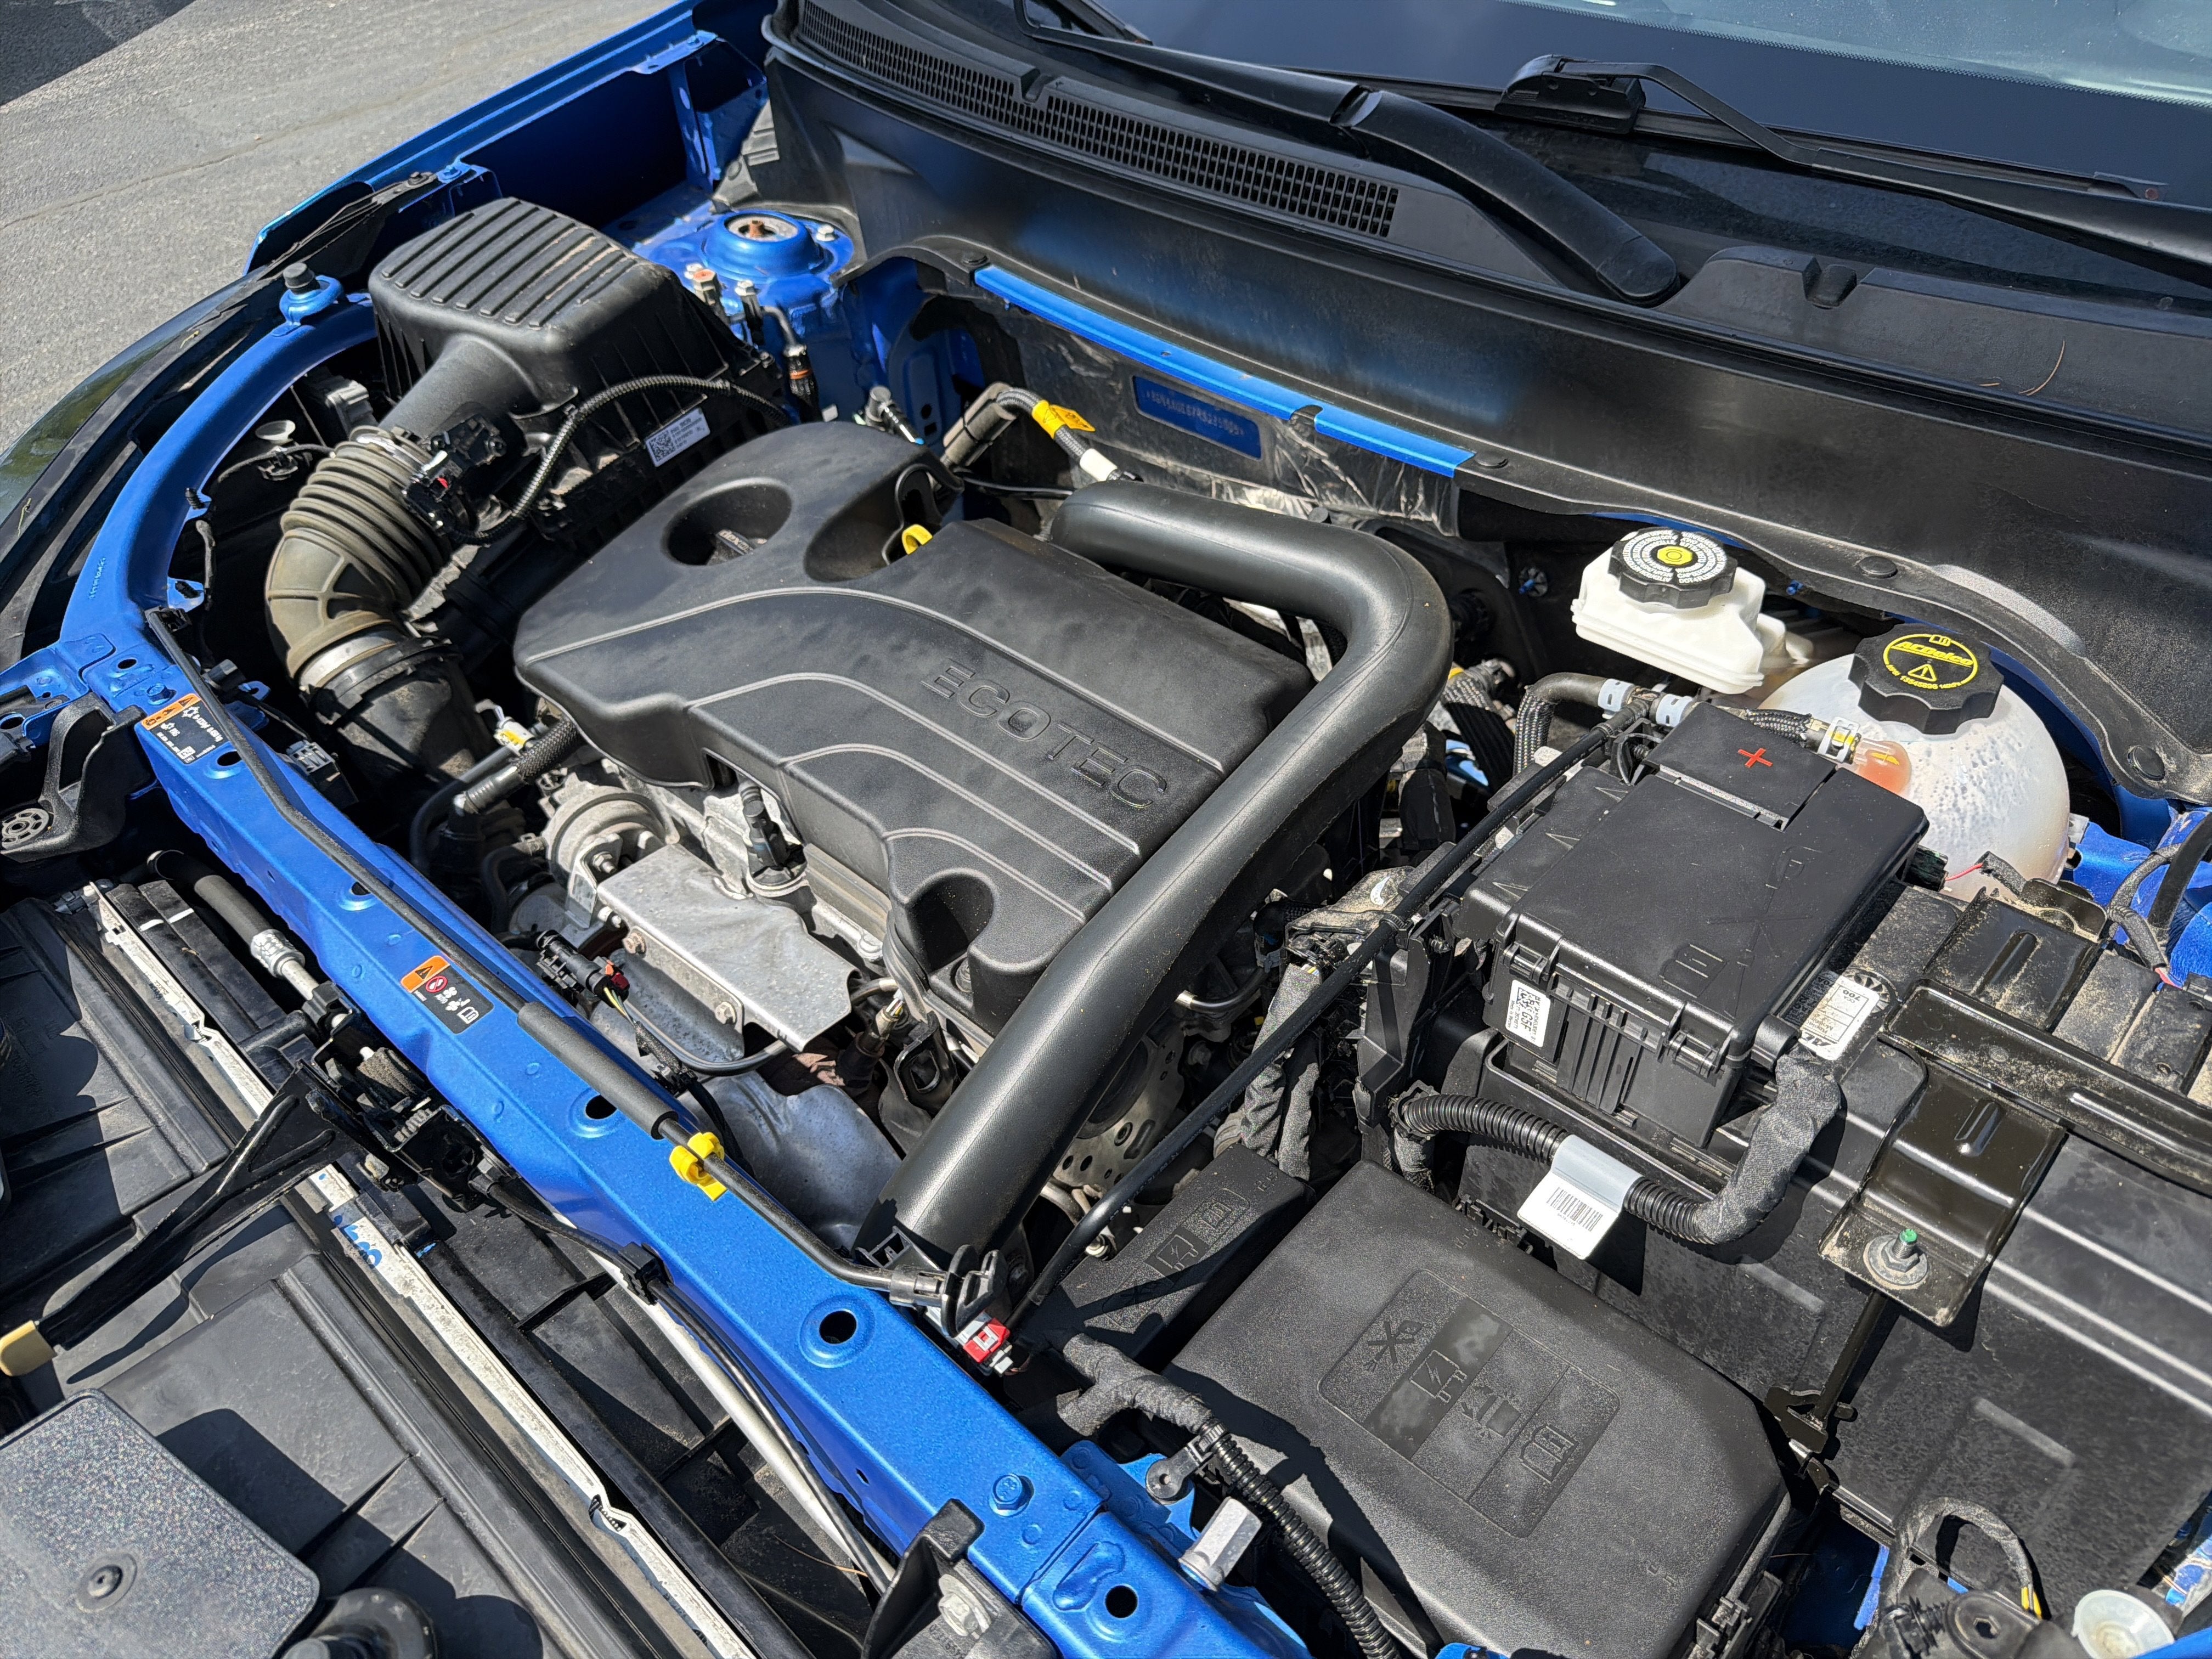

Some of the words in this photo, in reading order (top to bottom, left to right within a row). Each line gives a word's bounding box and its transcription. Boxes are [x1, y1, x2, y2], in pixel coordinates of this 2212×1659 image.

[1892, 641, 1973, 665] ACDelco
[921, 658, 1167, 809] ECOTEC
[434, 993, 448, 1004] AUTO
[1842, 989, 1861, 1001] 700
